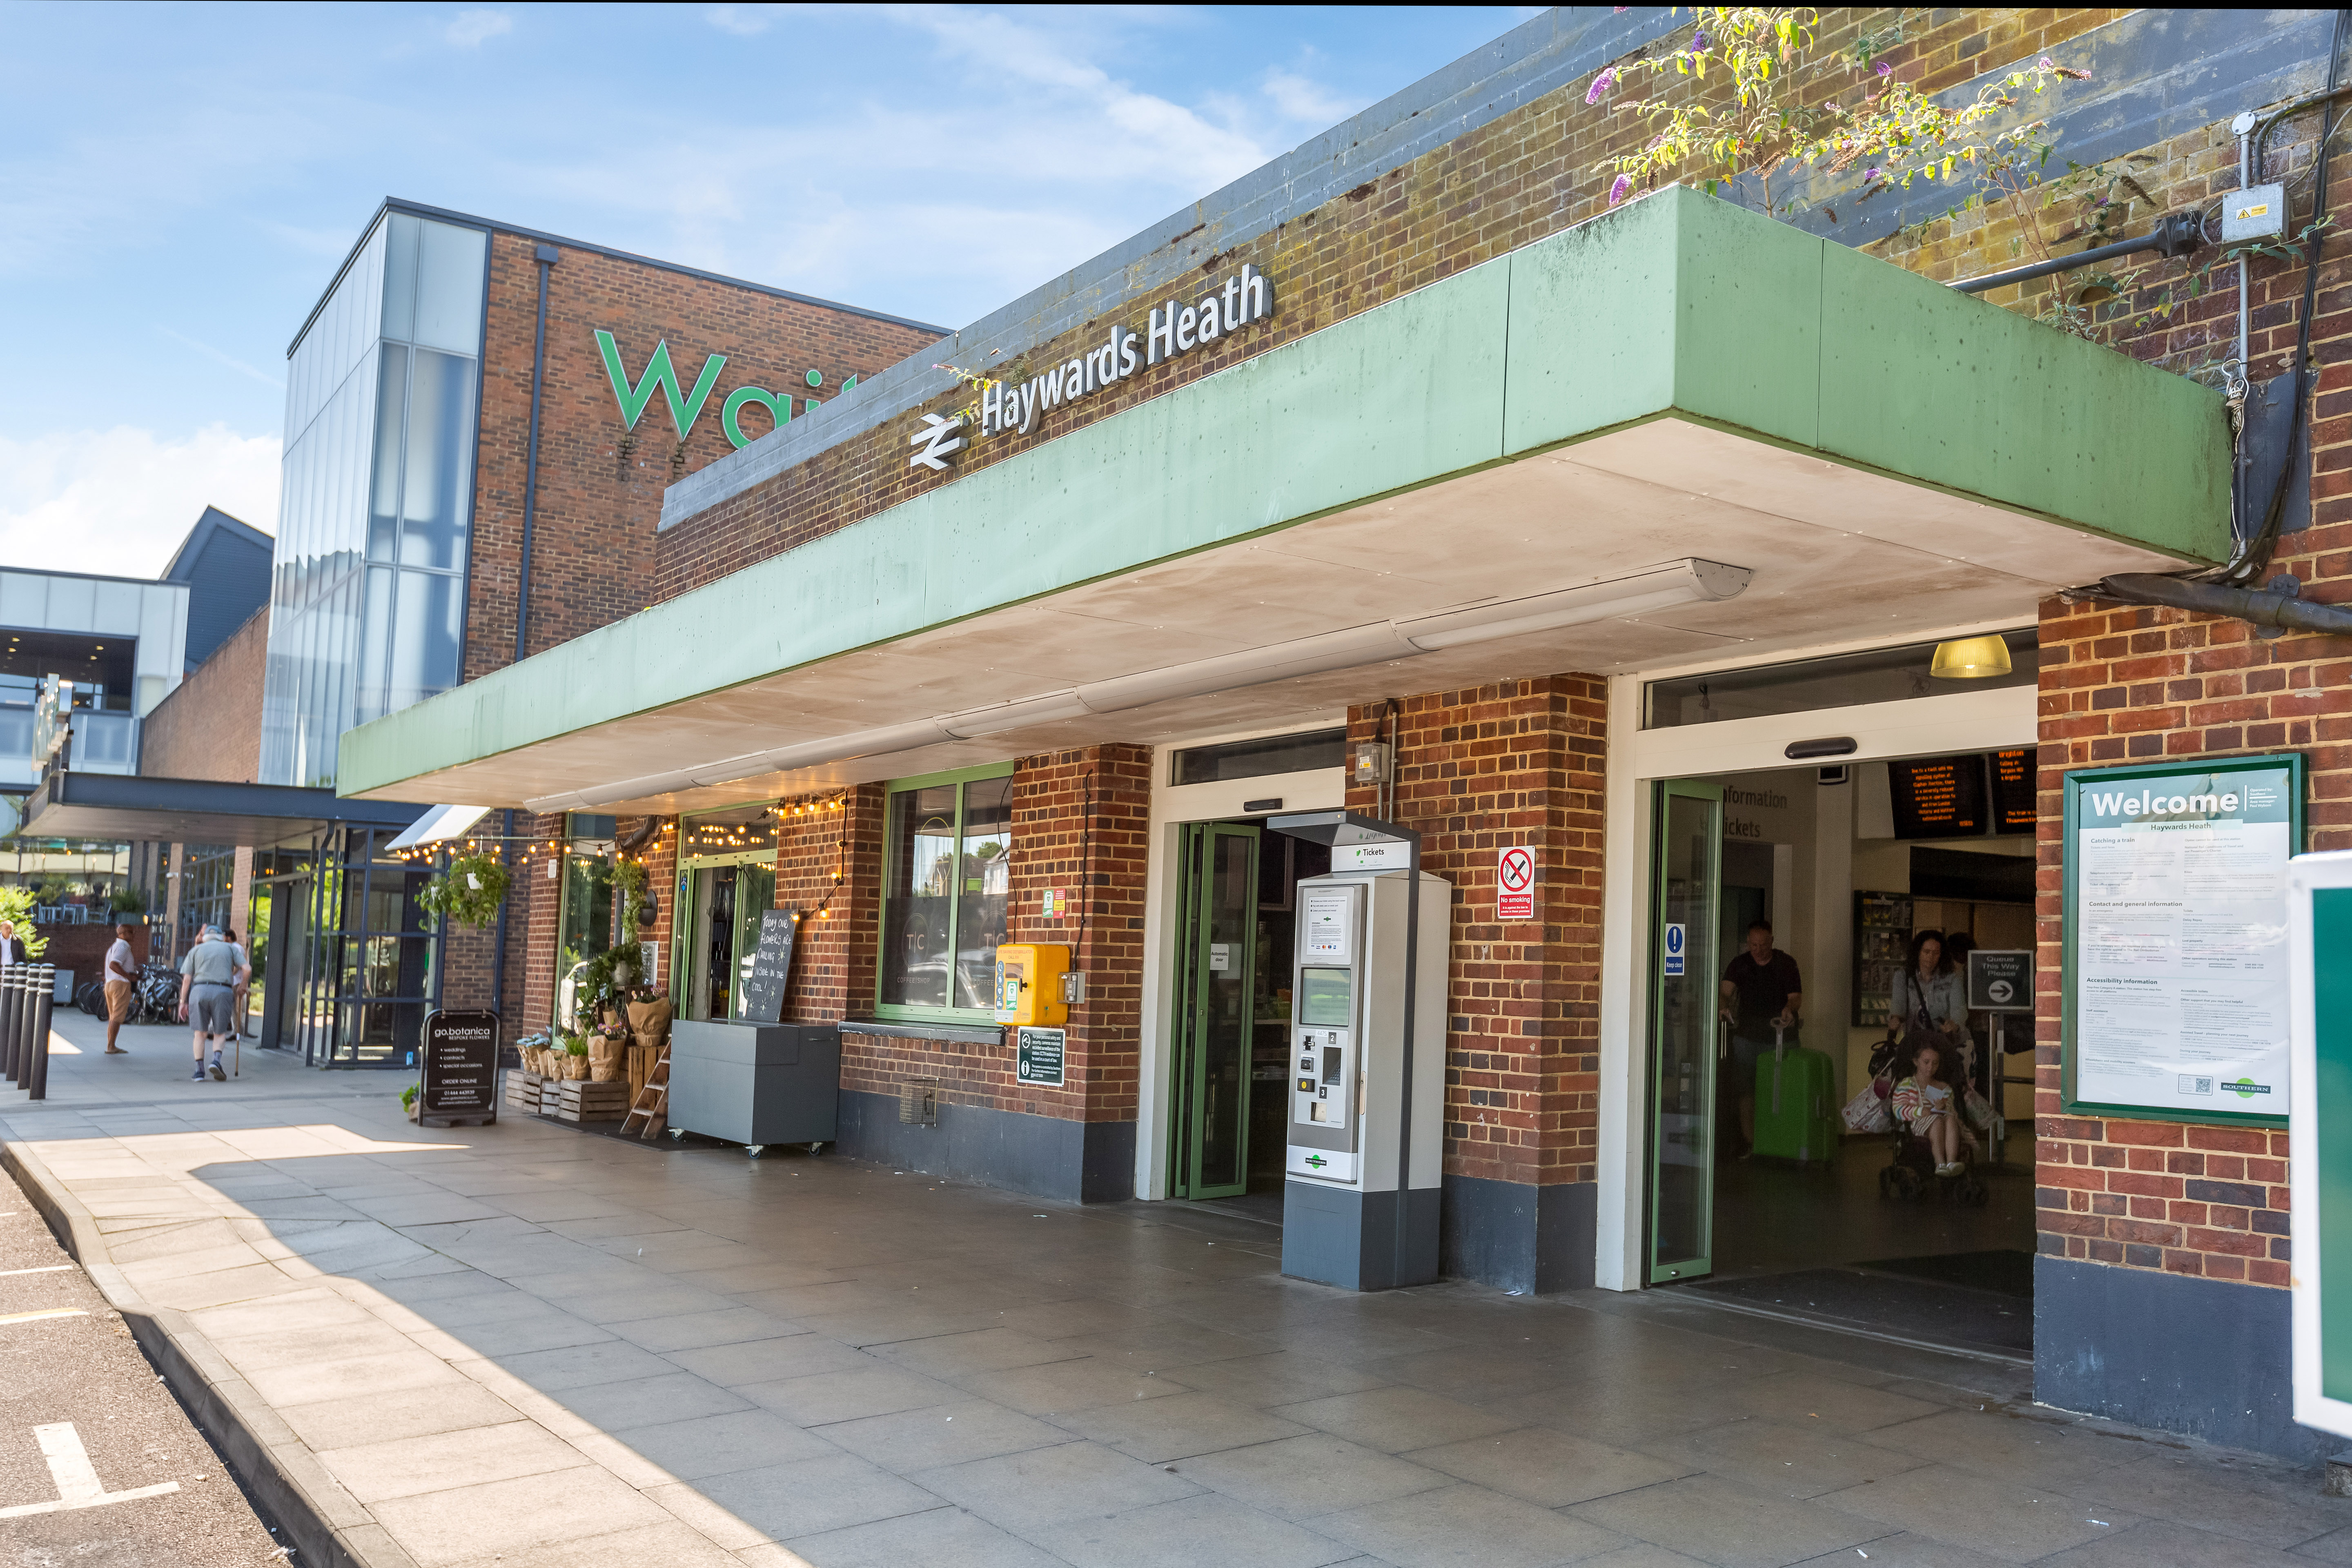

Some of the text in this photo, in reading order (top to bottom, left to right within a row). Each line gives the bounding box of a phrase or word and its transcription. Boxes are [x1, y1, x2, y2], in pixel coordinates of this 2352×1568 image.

[982, 263, 1269, 437] Haywards Heath
[1723, 785, 1787, 808] nformation
[2092, 789, 2238, 816] Welcome
[1724, 818, 1760, 837] ickets
[2151, 823, 2187, 832] Haywards
[763, 915, 788, 931] TODAY OUR
[783, 934, 791, 945] ARE
[755, 967, 768, 976] INSIDE
[434, 1027, 490, 1038] go.botanica
